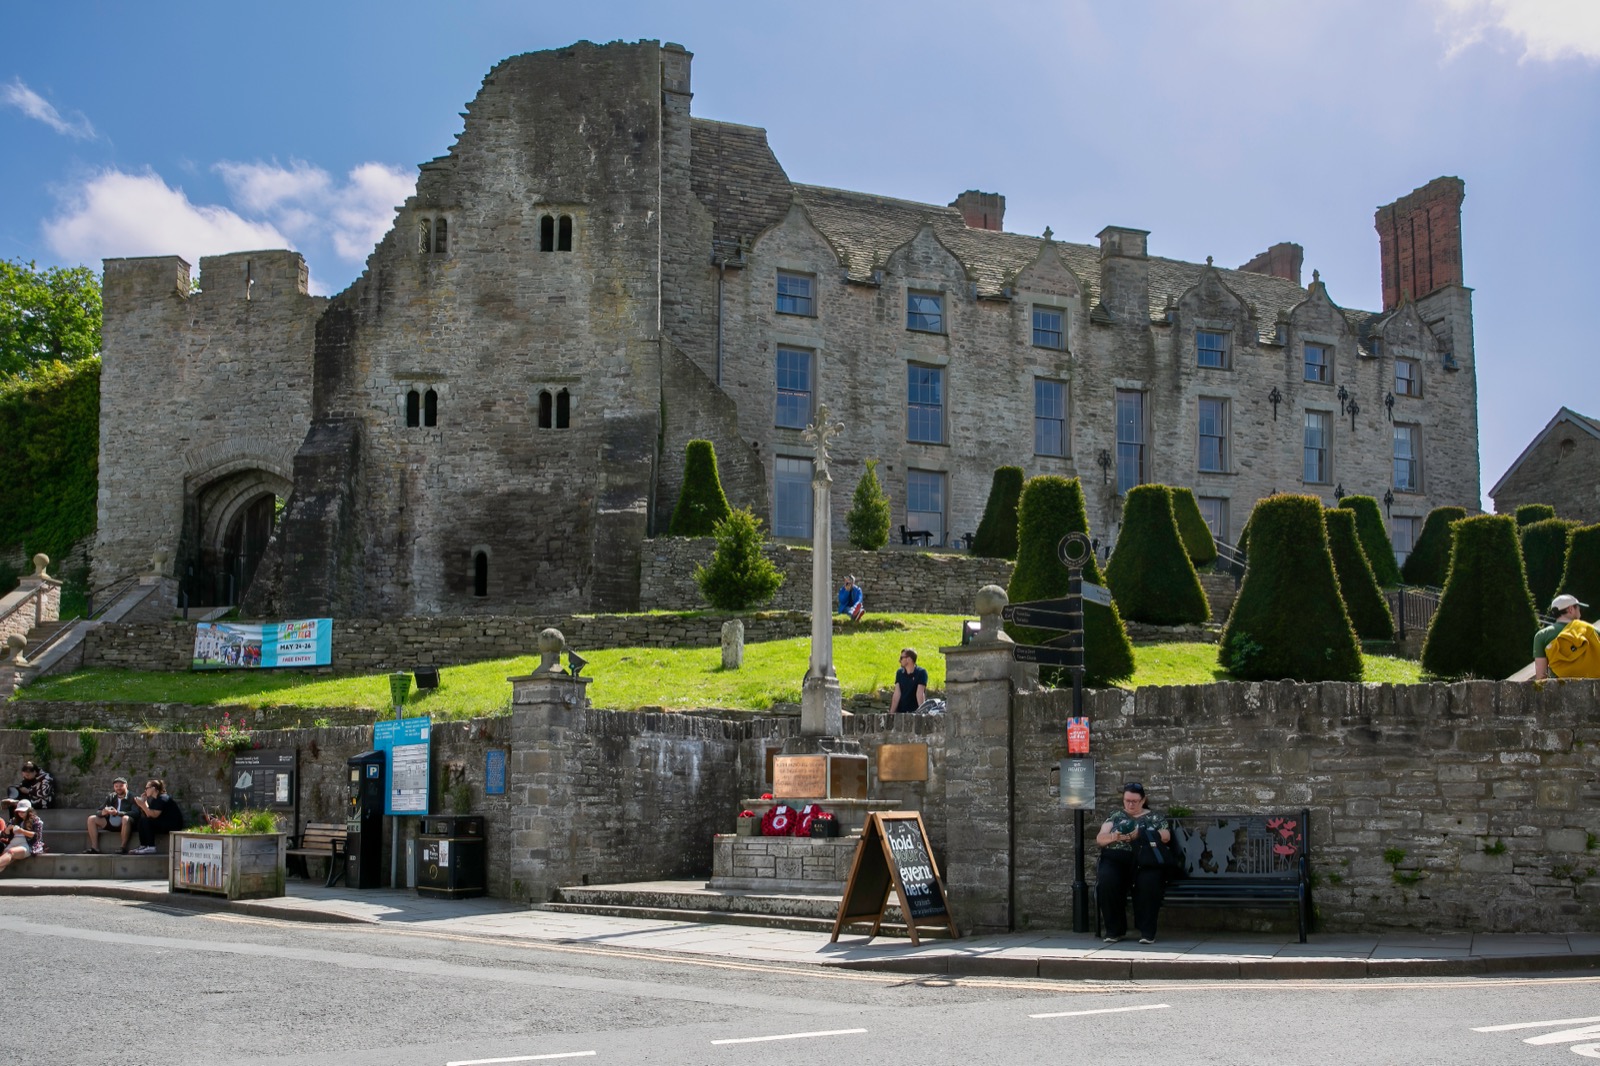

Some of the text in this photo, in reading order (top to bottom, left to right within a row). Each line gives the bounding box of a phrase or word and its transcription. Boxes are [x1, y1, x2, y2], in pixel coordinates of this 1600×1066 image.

[370, 767, 377, 776] P
[888, 834, 914, 850] hold
[893, 849, 919, 863] your
[900, 865, 933, 882] event
[902, 880, 932, 896] here.
